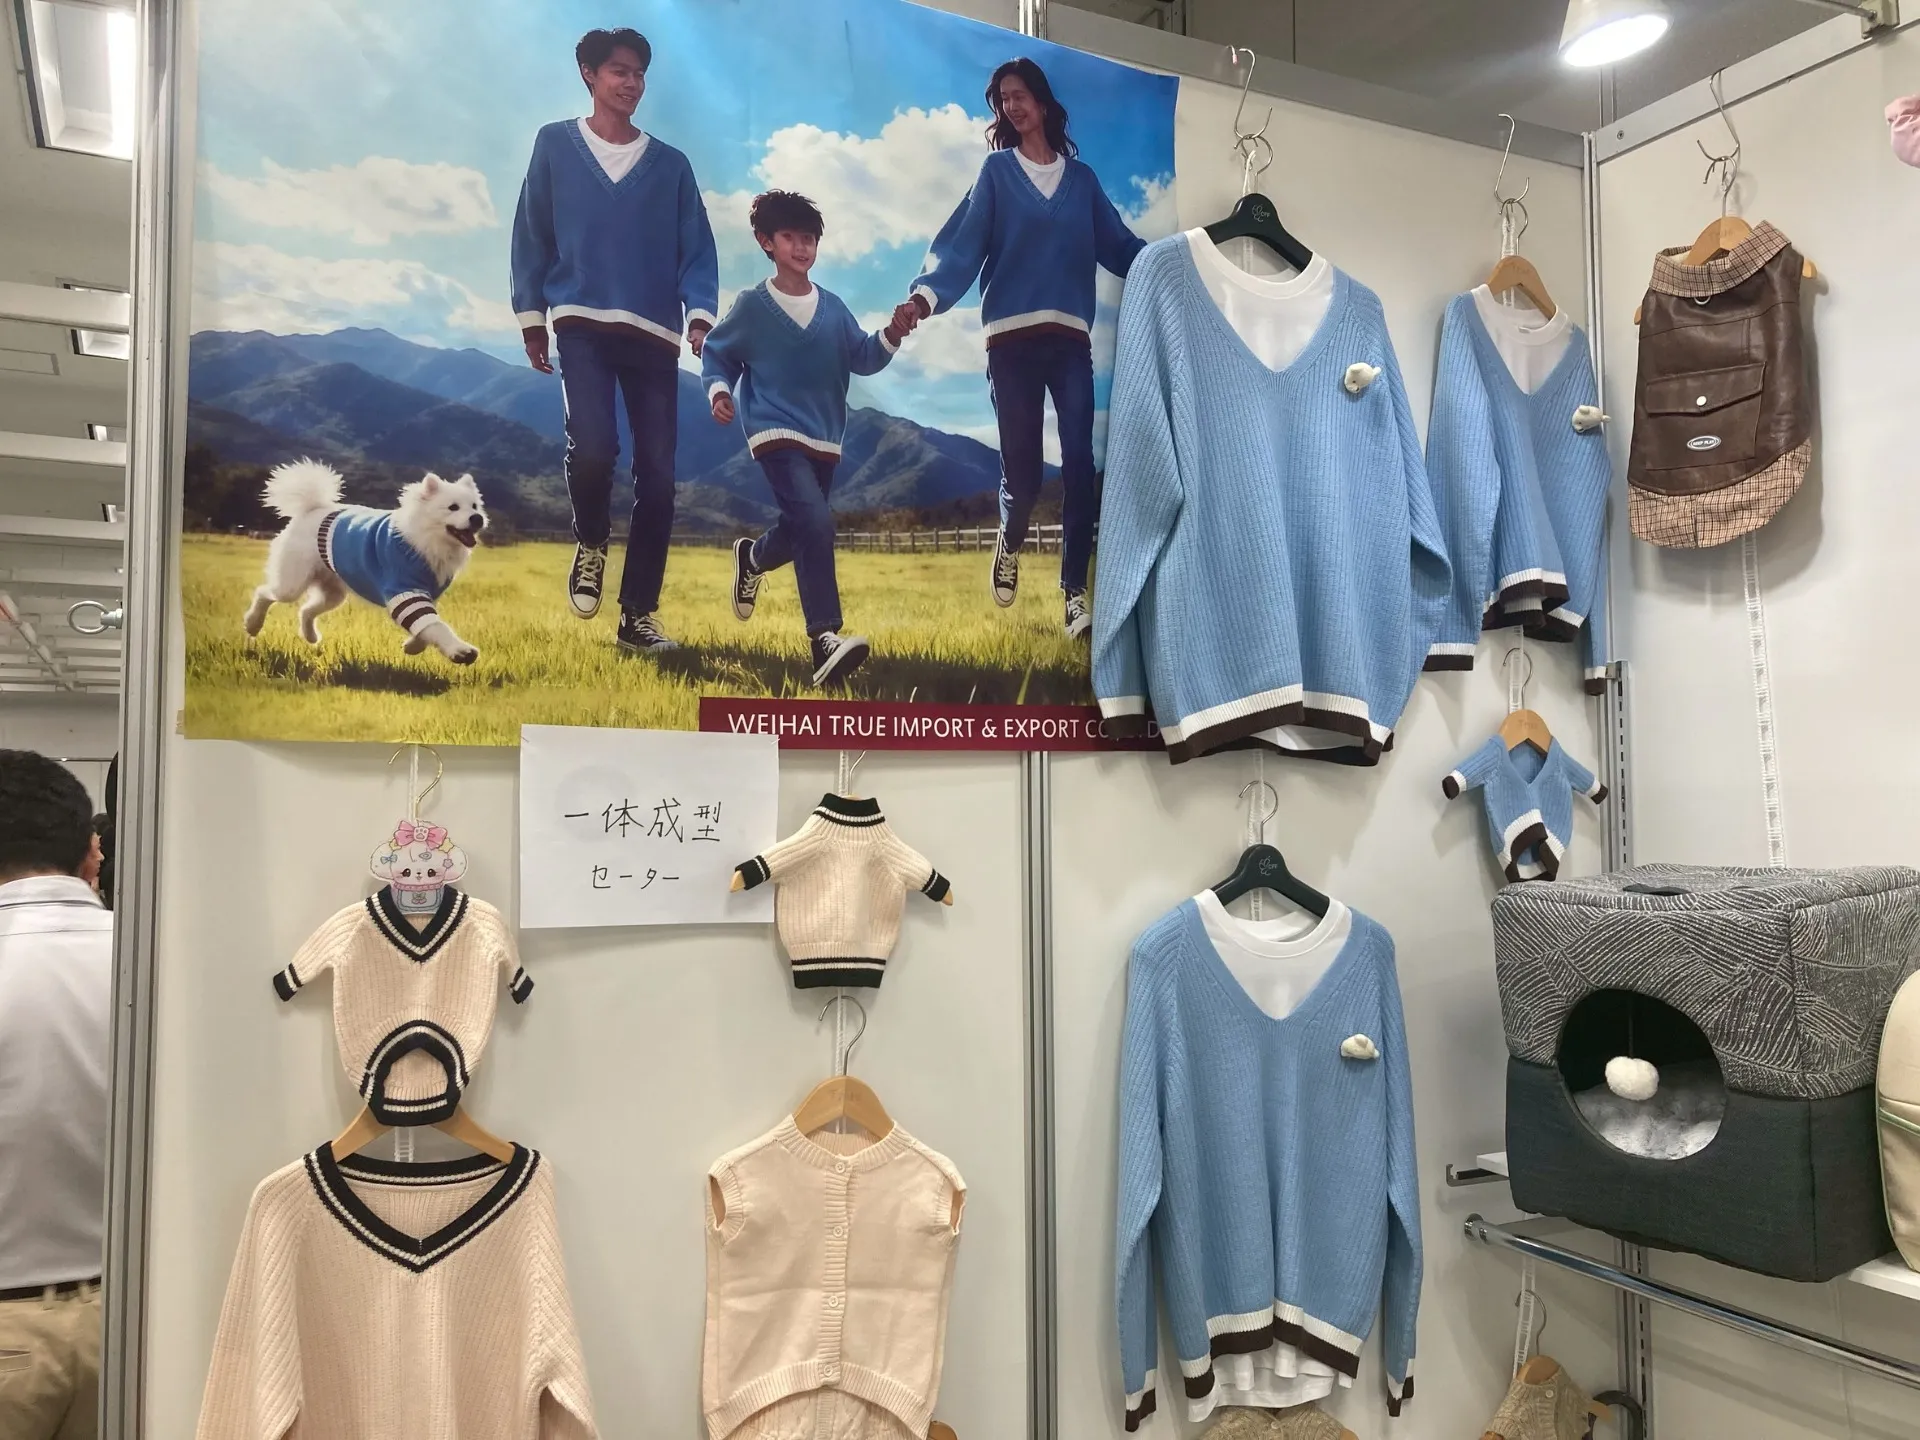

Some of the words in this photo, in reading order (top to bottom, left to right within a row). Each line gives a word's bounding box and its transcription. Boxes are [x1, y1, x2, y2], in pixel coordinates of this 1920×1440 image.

[728, 713, 821, 736] WEIHAI
[829, 715, 886, 737] TRUE
[893, 716, 975, 738] IMPORT
[981, 718, 998, 738] &
[1004, 718, 1080, 739] EXPORT
[564, 797, 722, 843] 一体成型
[592, 864, 680, 890] セーター
